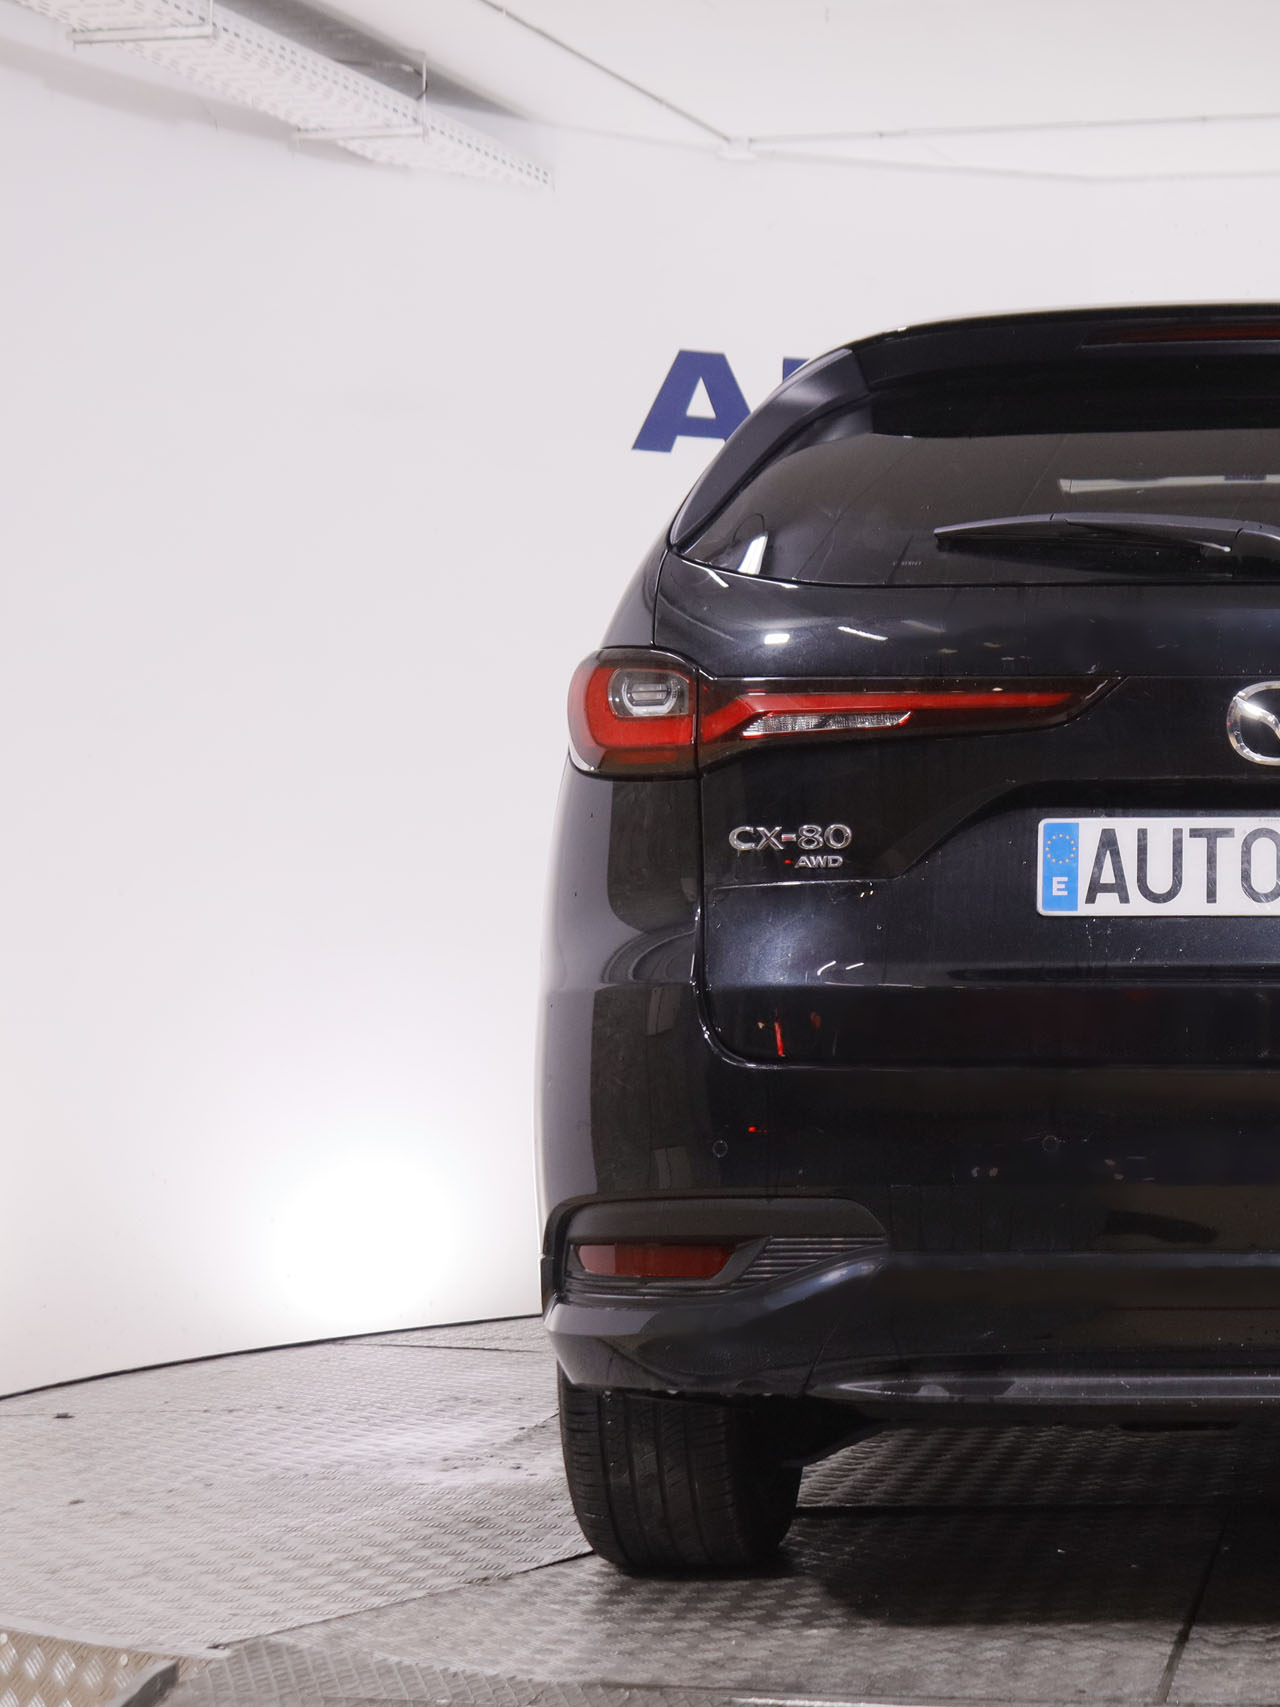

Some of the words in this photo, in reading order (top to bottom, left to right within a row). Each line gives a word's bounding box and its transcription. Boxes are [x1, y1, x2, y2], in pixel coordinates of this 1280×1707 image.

[631, 349, 810, 453] A
[728, 824, 852, 851] CX-80
[794, 855, 843, 869] AWD
[1052, 876, 1069, 896] E
